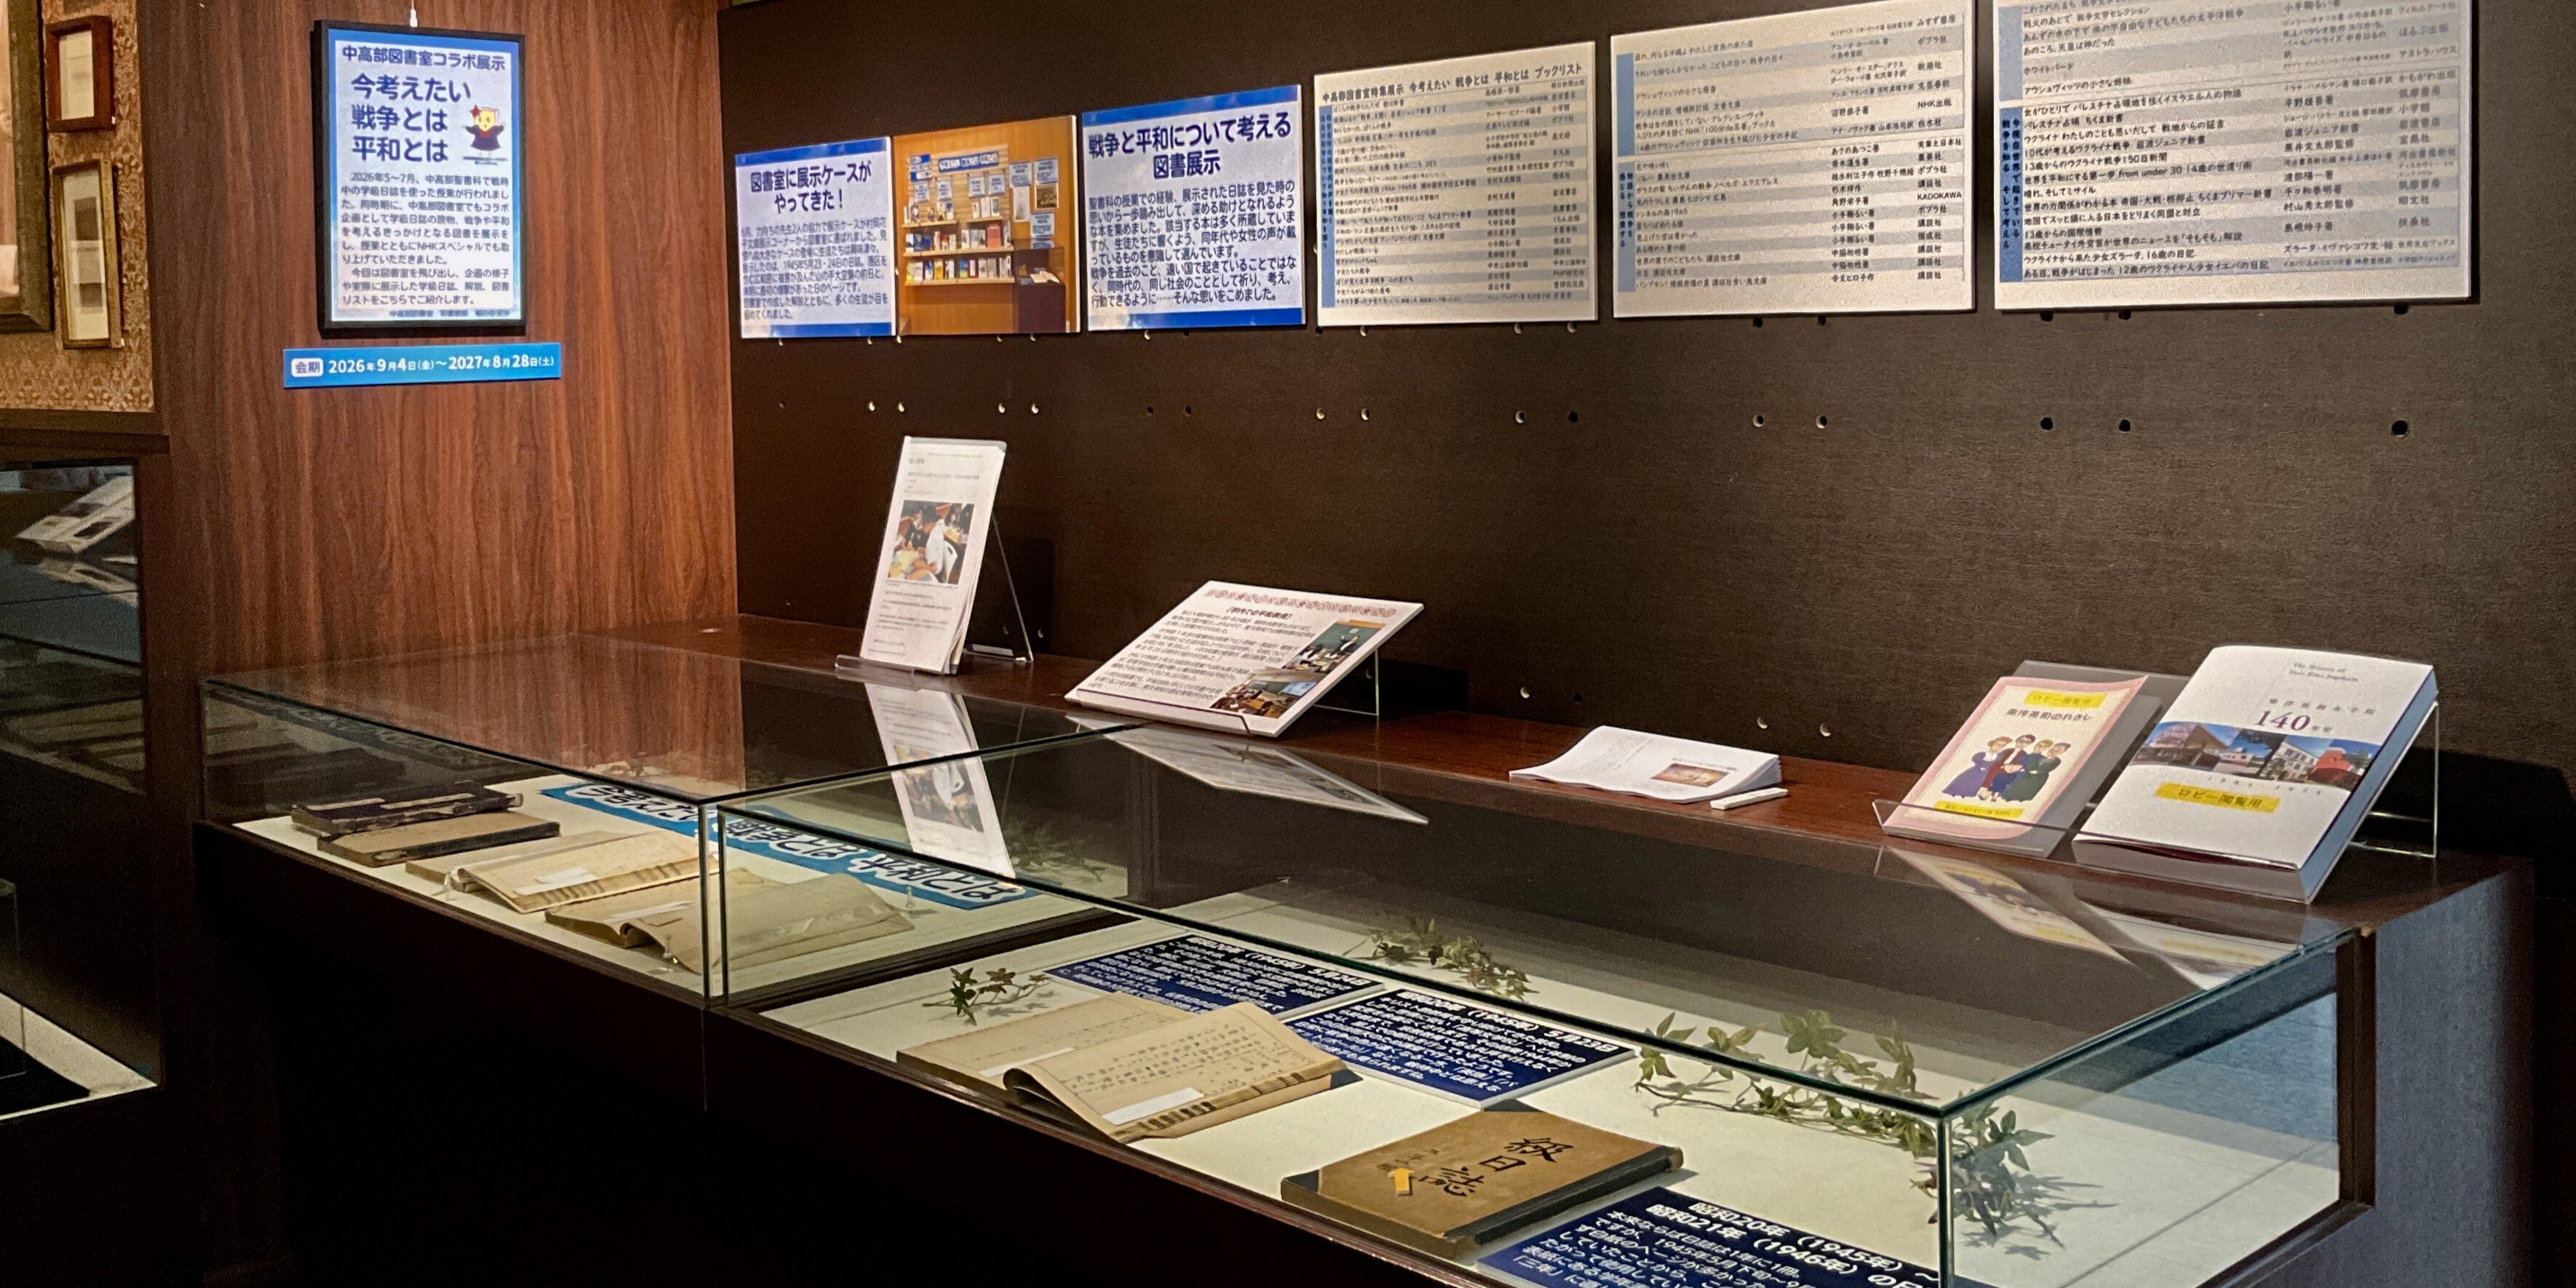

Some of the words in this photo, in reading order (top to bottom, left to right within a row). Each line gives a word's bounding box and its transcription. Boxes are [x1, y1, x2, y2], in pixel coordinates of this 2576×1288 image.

[342, 45, 506, 71] 中高部図書室コラボ展示
[351, 74, 472, 103] 今考えたい
[351, 104, 448, 131] 戦争とは
[1089, 112, 1292, 159] 戦争と平和について考える
[352, 138, 448, 162] 平和とは
[750, 161, 872, 193] 図書室に展示ケースが
[1153, 149, 1221, 179] 図書展示
[775, 188, 843, 214] やってきた！
[343, 254, 448, 265] り上げていただきました。
[295, 360, 321, 374] 会期
[578, 784, 700, 821] 今考えた
